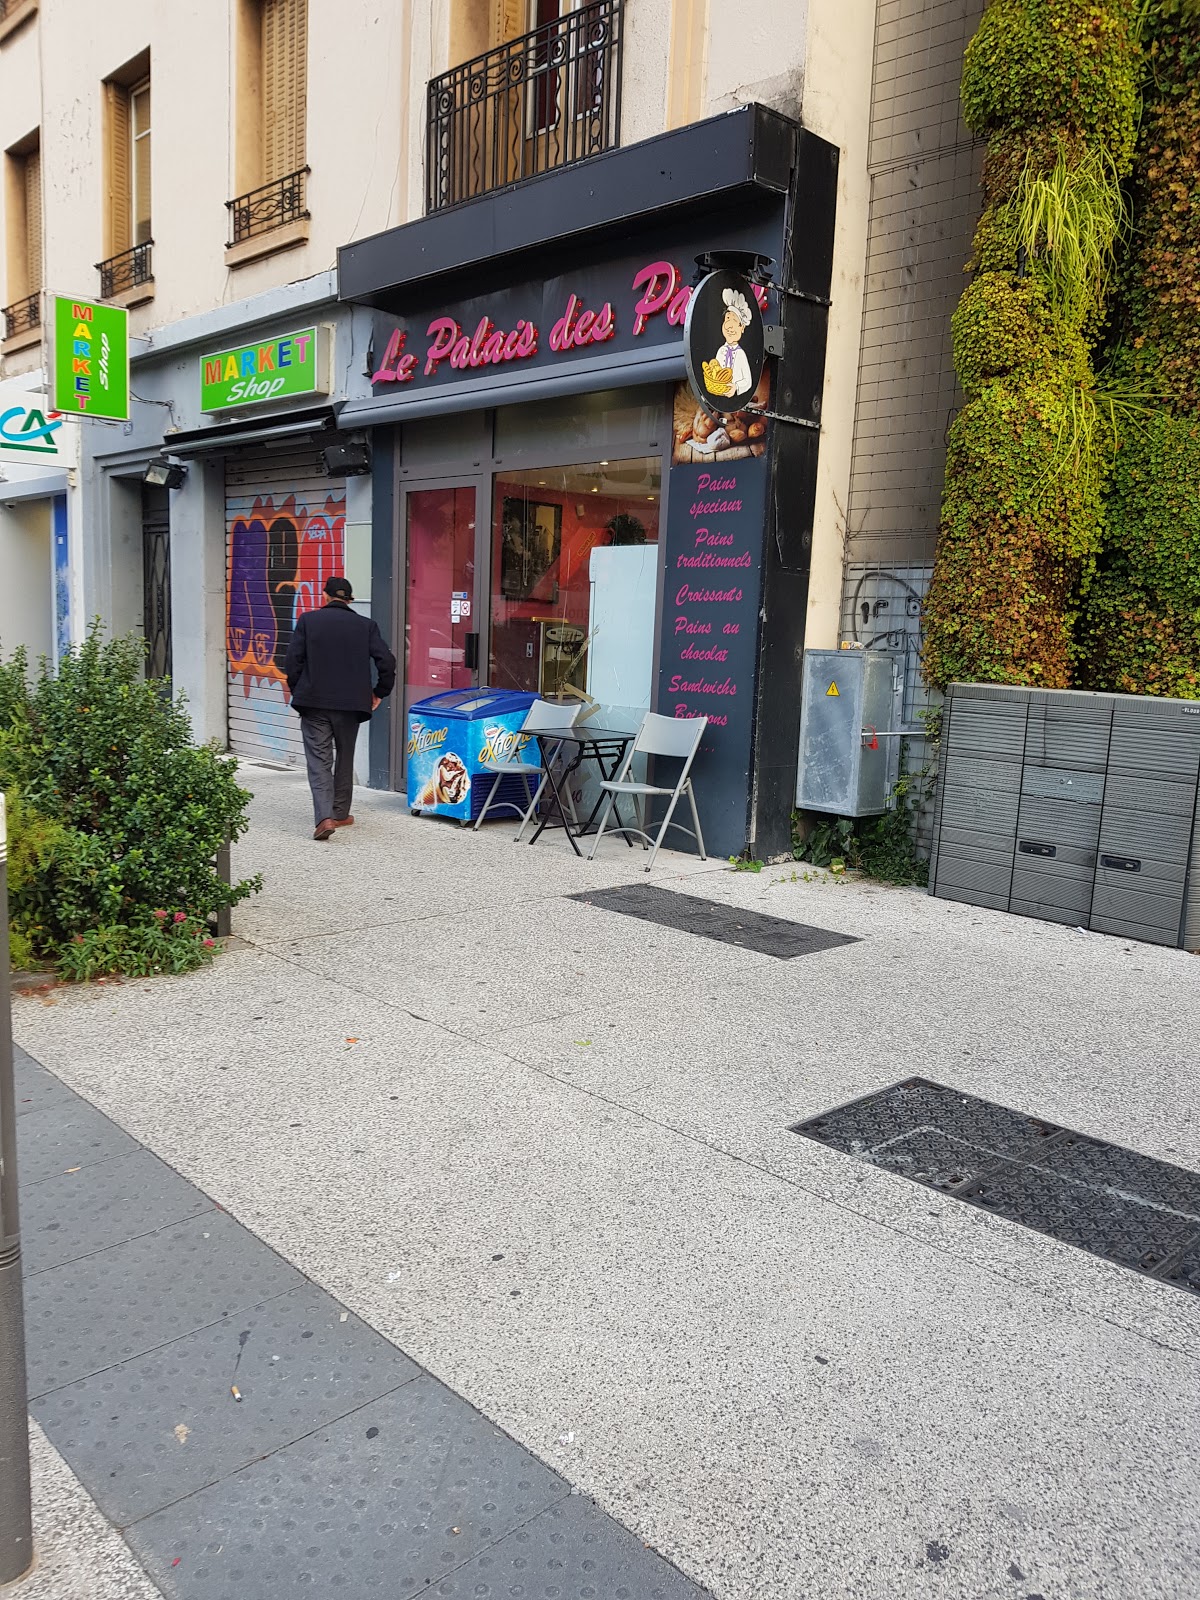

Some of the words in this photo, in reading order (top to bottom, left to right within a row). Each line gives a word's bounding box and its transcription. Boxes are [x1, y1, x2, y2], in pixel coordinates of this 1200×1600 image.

[372, 327, 415, 386] Le
[425, 315, 538, 376] Palais
[549, 293, 614, 352] des
[71, 303, 93, 410] MARKET
[99, 332, 112, 391] Shop
[204, 335, 311, 386] MARKET
[226, 376, 286, 402] Shop
[697, 473, 737, 494] Pains
[688, 497, 743, 519] speciaux
[694, 527, 735, 548] Pains
[676, 552, 752, 569] traditionnels
[675, 583, 743, 606] Croissants
[674, 616, 712, 636] Pains
[722, 623, 740, 635] au
[680, 643, 729, 663] chocolat
[668, 674, 737, 696] Sandwichs
